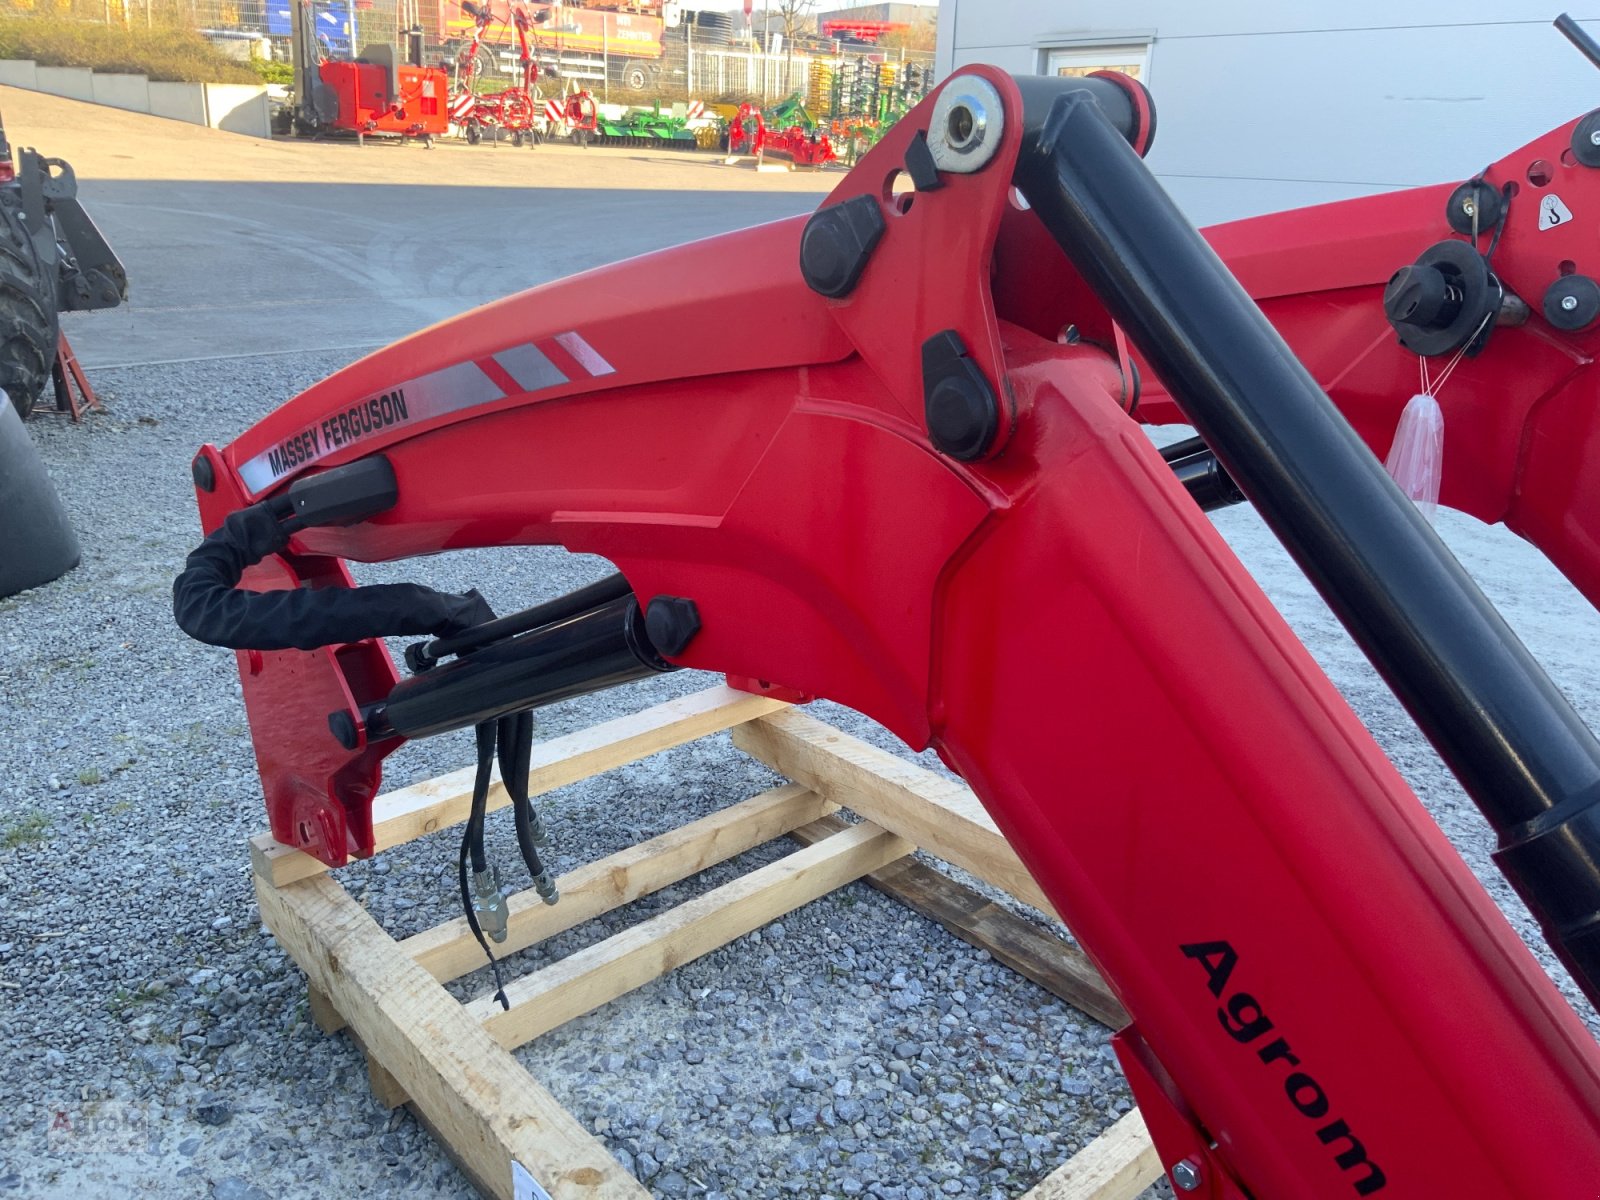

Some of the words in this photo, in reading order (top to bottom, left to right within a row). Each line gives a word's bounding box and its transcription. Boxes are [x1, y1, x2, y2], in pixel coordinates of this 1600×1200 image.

[268, 427, 320, 477] MASSEY
[323, 389, 409, 449] FERGUSON
[1178, 940, 1387, 1198] Agrom
